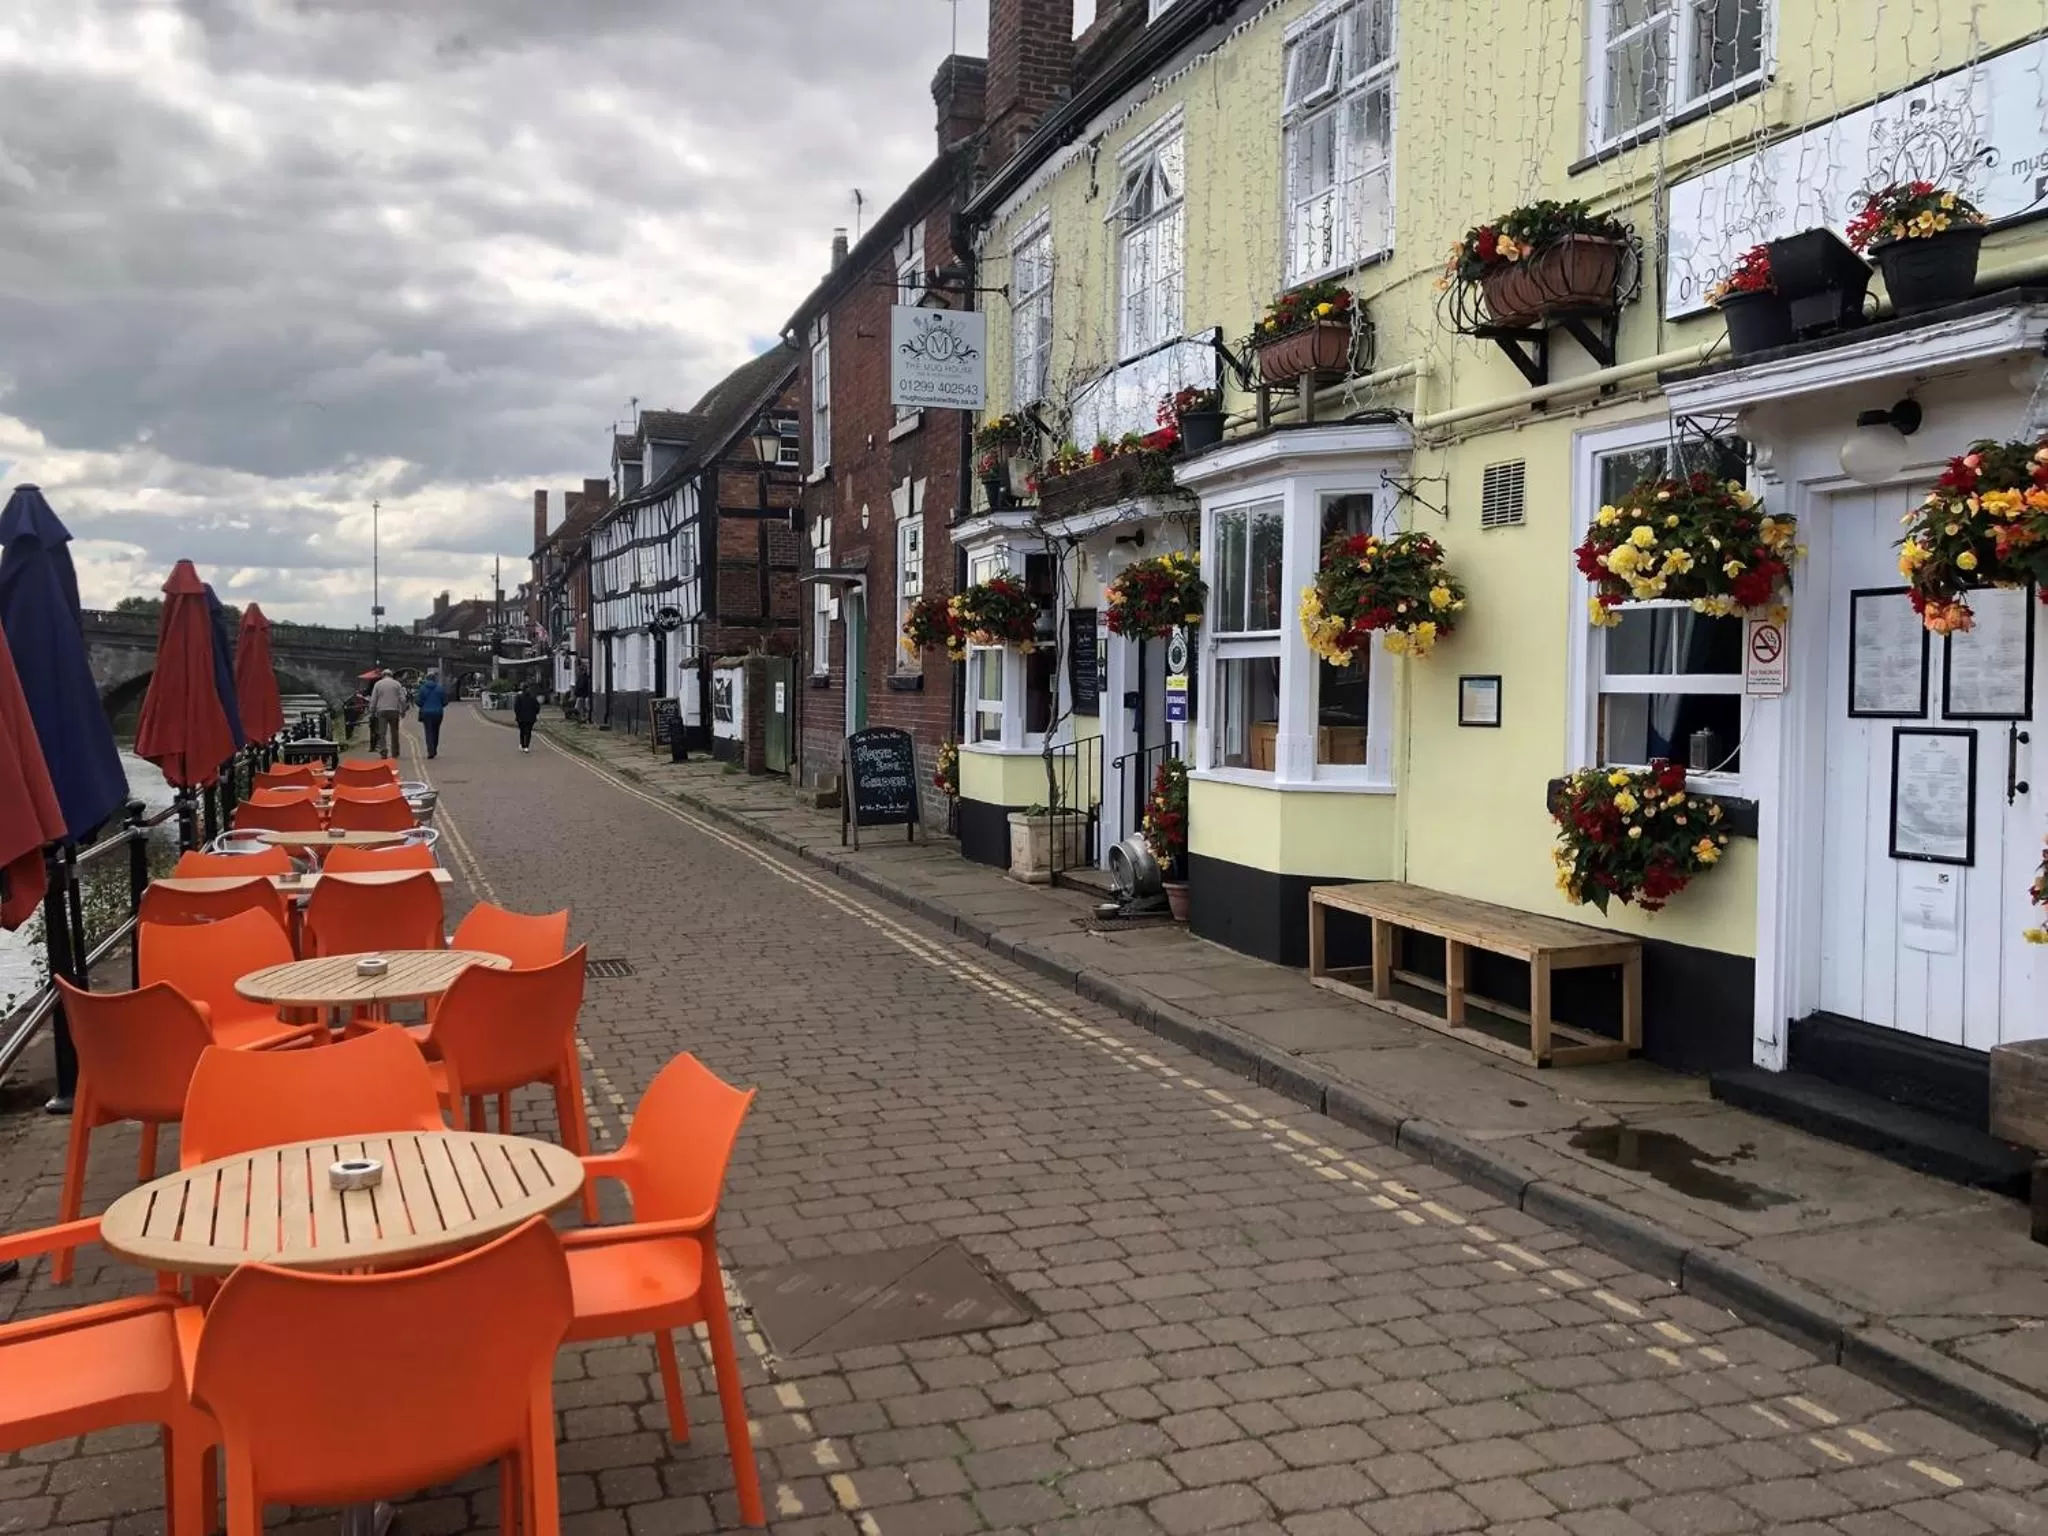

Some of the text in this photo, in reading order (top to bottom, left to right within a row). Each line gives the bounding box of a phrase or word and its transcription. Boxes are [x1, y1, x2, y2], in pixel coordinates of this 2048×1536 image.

[930, 335, 949, 355] M
[900, 379, 978, 395] 01299 402543
